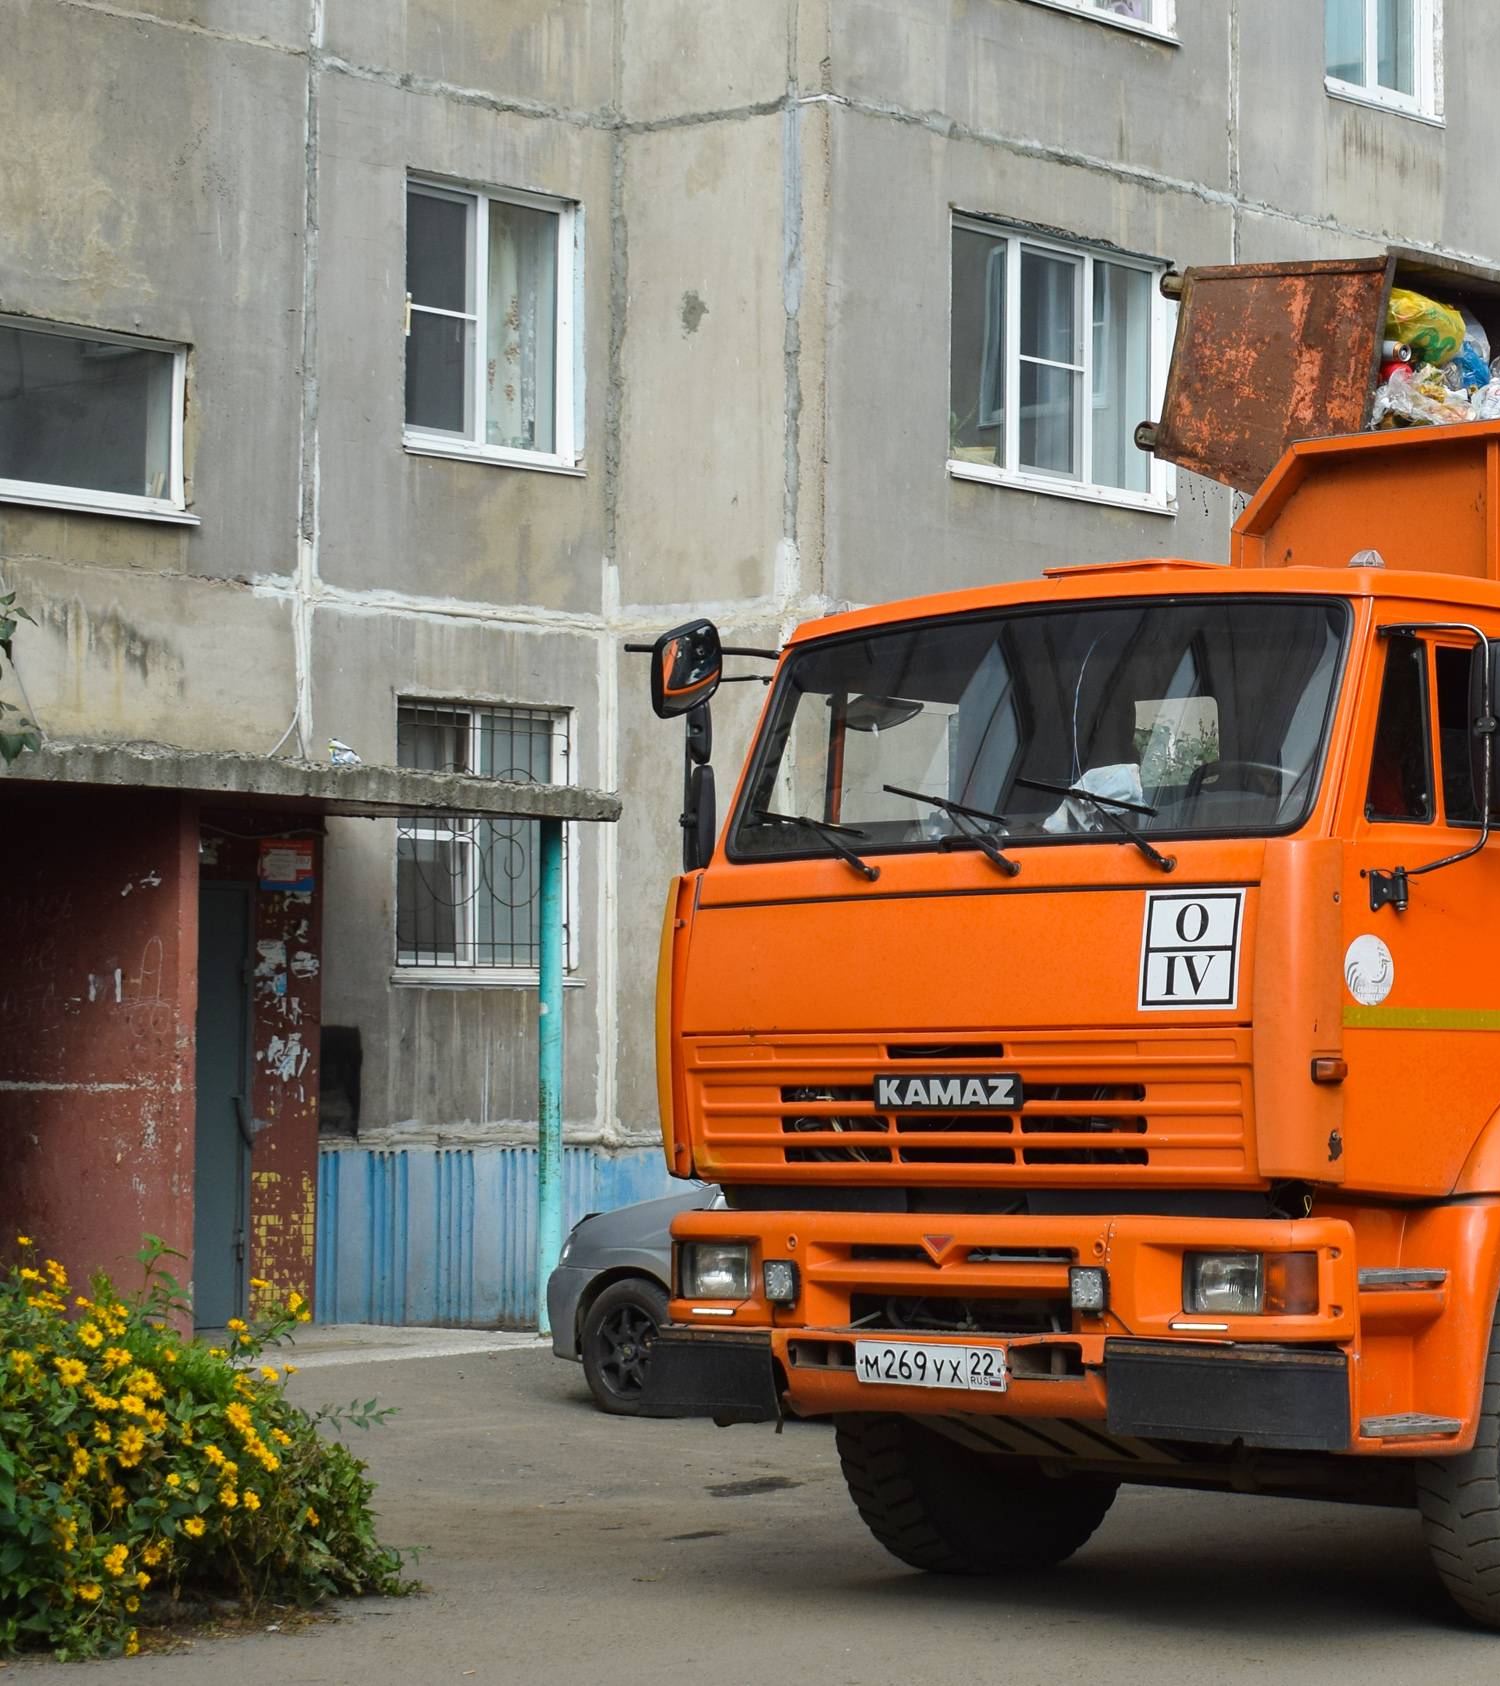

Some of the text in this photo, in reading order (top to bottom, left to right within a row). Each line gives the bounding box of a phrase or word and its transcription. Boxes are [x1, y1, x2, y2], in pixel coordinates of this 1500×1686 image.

[1176, 903, 1209, 942] O
[1161, 955, 1216, 996] IV
[878, 1079, 1015, 1105] KAMAZ
[970, 1352, 994, 1376] 22
[970, 1376, 989, 1386] RUS
